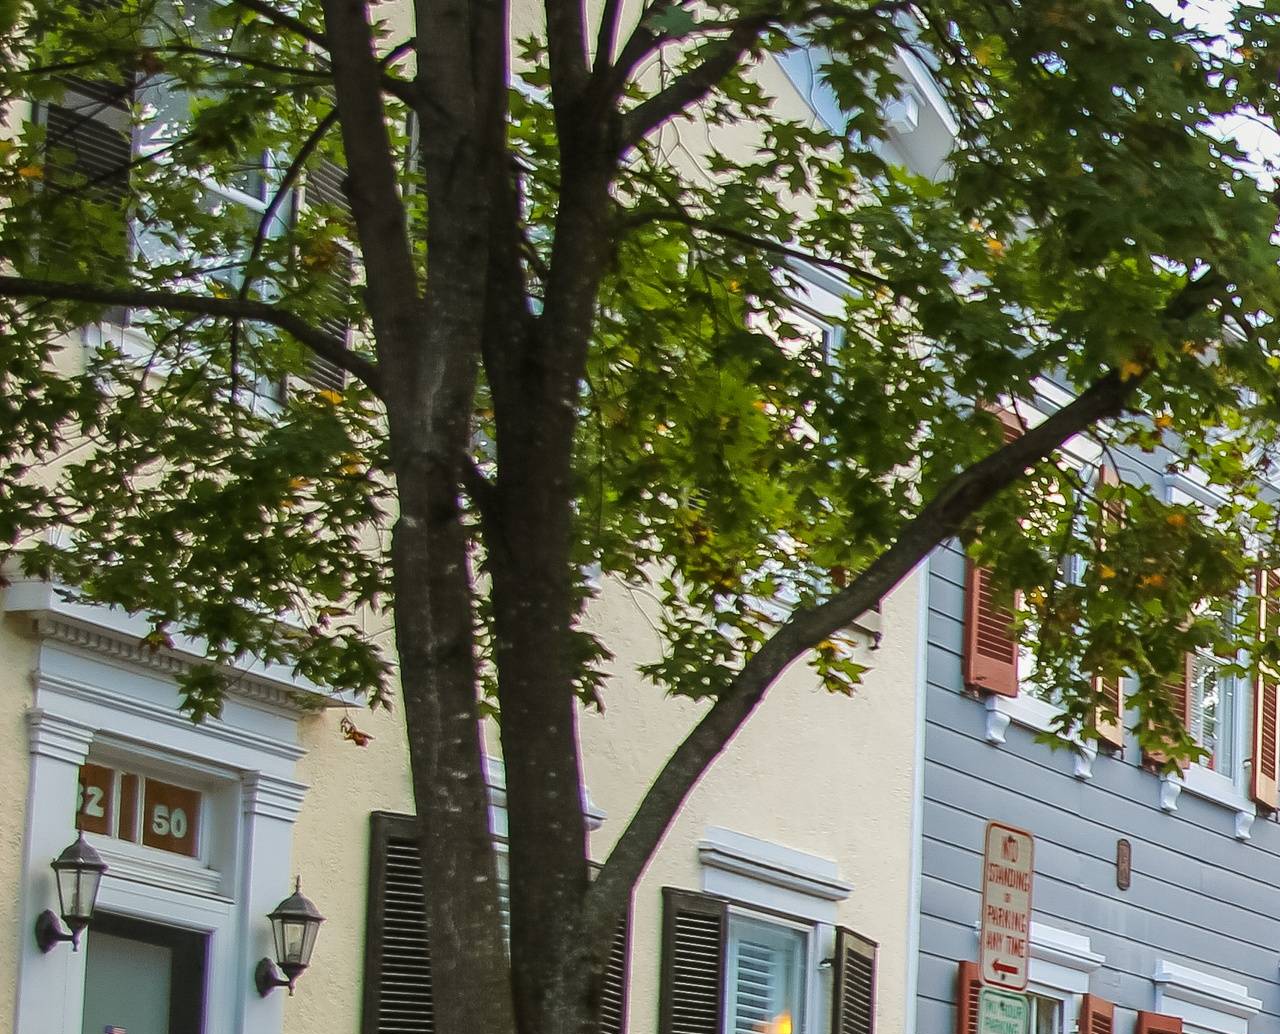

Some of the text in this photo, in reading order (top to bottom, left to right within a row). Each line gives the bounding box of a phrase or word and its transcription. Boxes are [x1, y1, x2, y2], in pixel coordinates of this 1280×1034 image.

[79, 783, 105, 818] 2
[152, 804, 188, 839] 50
[1002, 837, 1019, 863] NO
[987, 863, 1031, 893] STANDING
[986, 904, 1027, 933] PARKING
[986, 931, 1025, 959] ANY TIME
